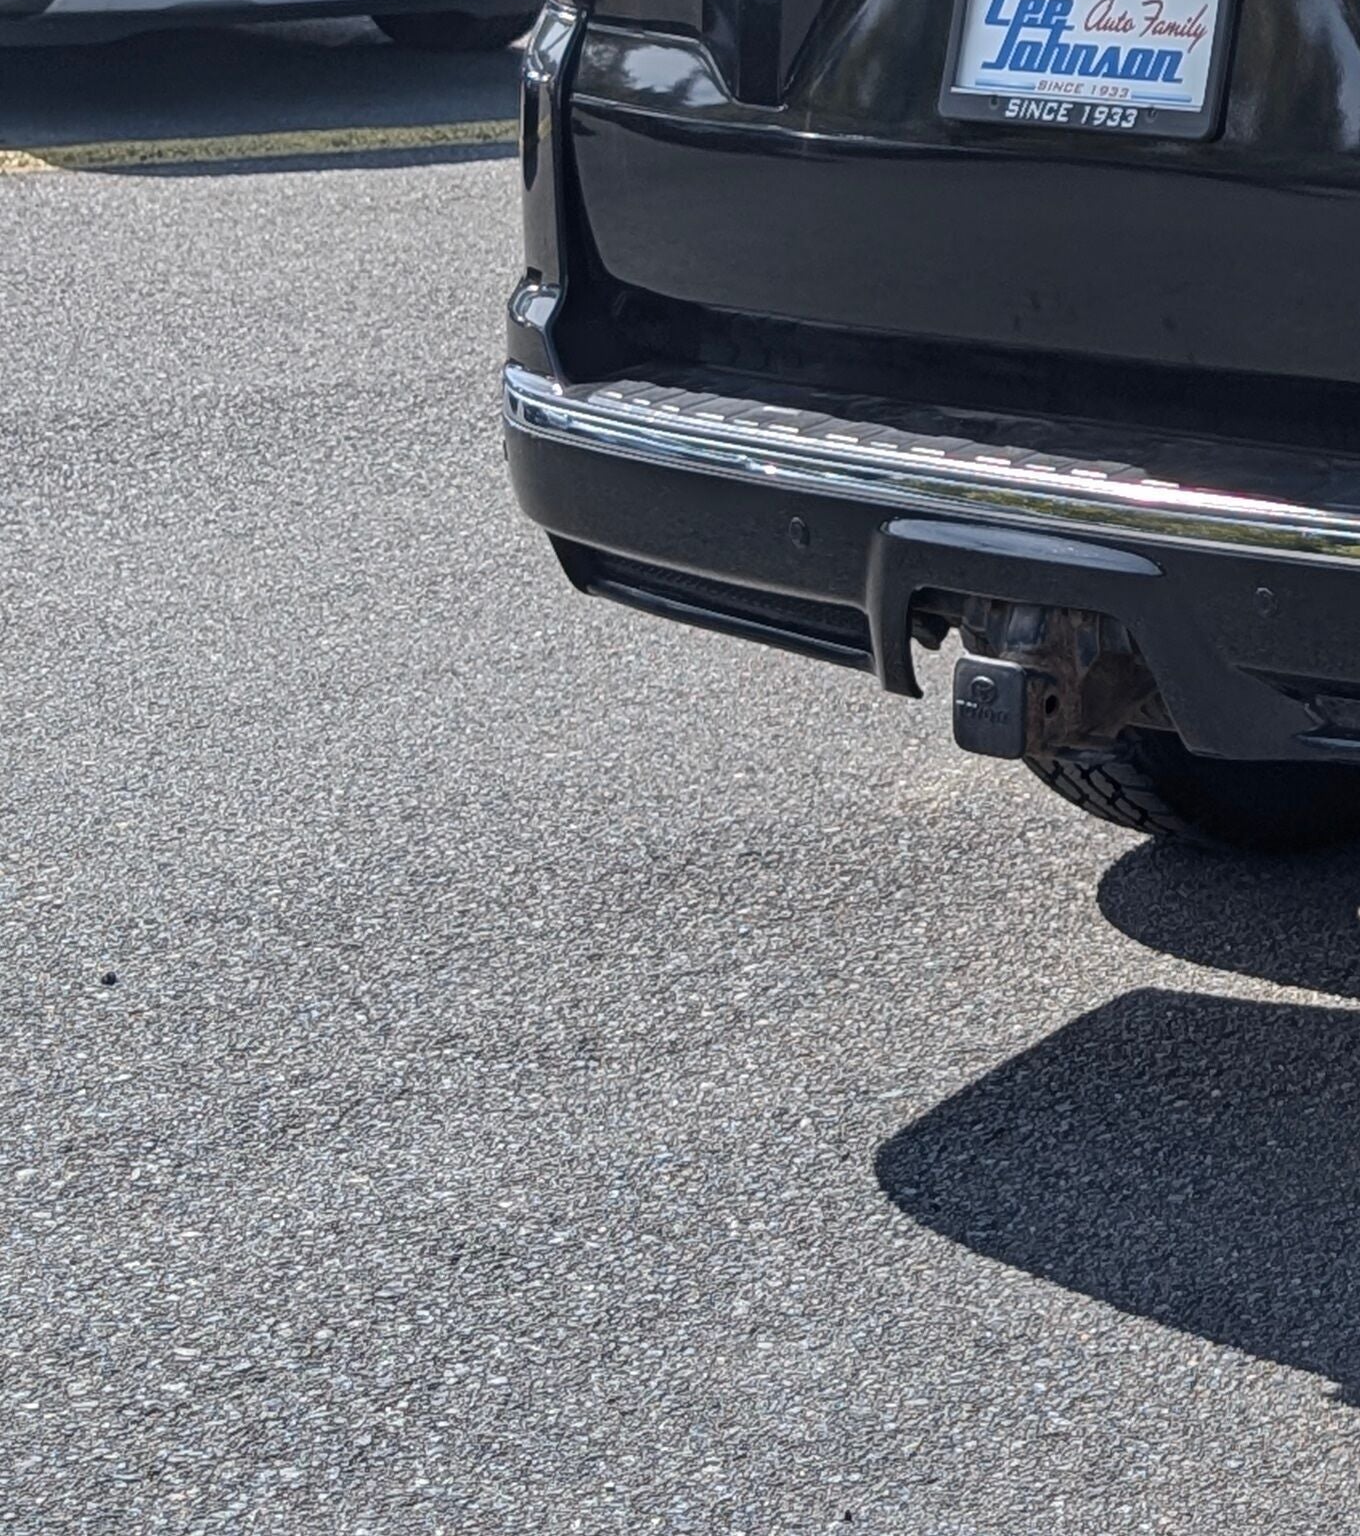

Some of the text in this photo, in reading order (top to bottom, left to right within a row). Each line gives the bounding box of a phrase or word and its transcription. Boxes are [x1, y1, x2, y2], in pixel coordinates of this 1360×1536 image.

[1139, 0, 1208, 53] Family
[981, 21, 1183, 84] Johnson
[1037, 80, 1130, 99] SINCE 1933
[1005, 99, 1138, 128] SINCE 1933
